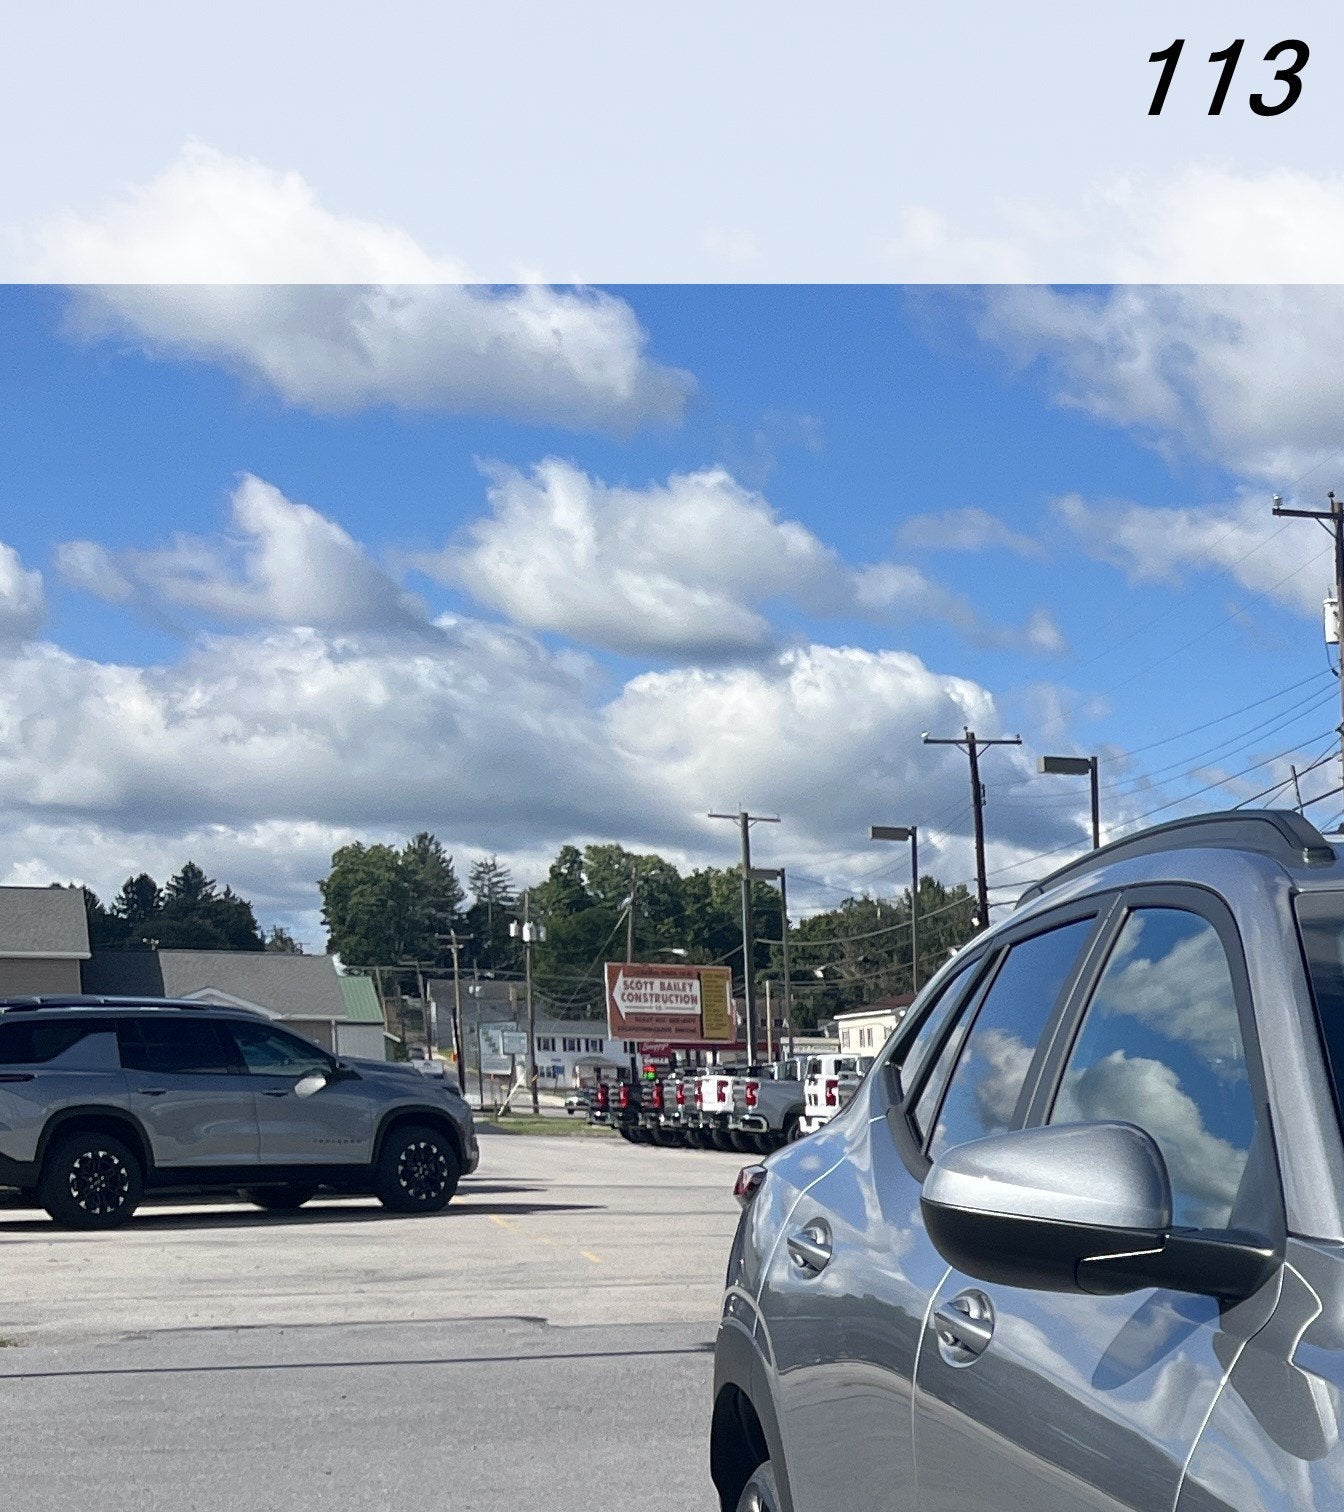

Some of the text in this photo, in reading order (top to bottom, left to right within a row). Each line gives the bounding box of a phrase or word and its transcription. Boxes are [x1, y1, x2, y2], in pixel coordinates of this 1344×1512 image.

[623, 981, 693, 992] SCOTT BAILEY
[621, 993, 698, 1005] CONSTRUCTION
